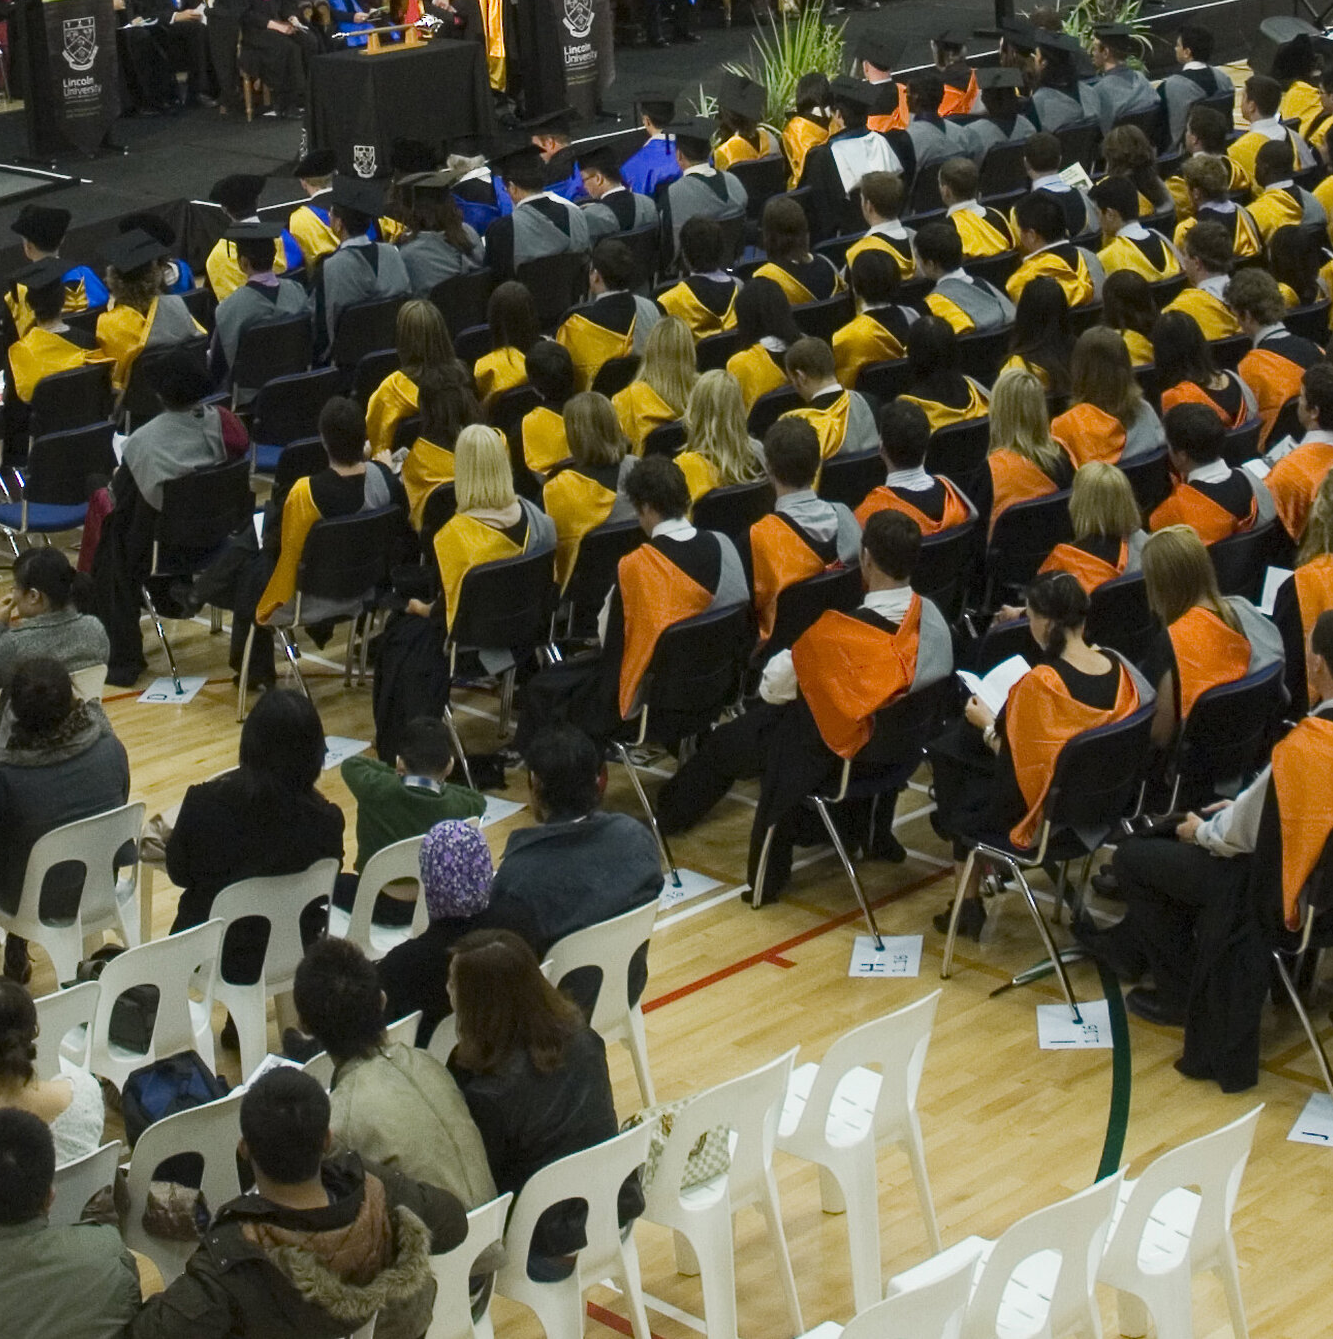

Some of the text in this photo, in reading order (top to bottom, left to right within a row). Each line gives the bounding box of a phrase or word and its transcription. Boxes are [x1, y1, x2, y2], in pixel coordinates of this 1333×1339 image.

[563, 43, 591, 55] Lincoln
[564, 51, 598, 63] University
[62, 75, 94, 88] Lincoln
[63, 84, 102, 97] University
[859, 963, 885, 972] H
